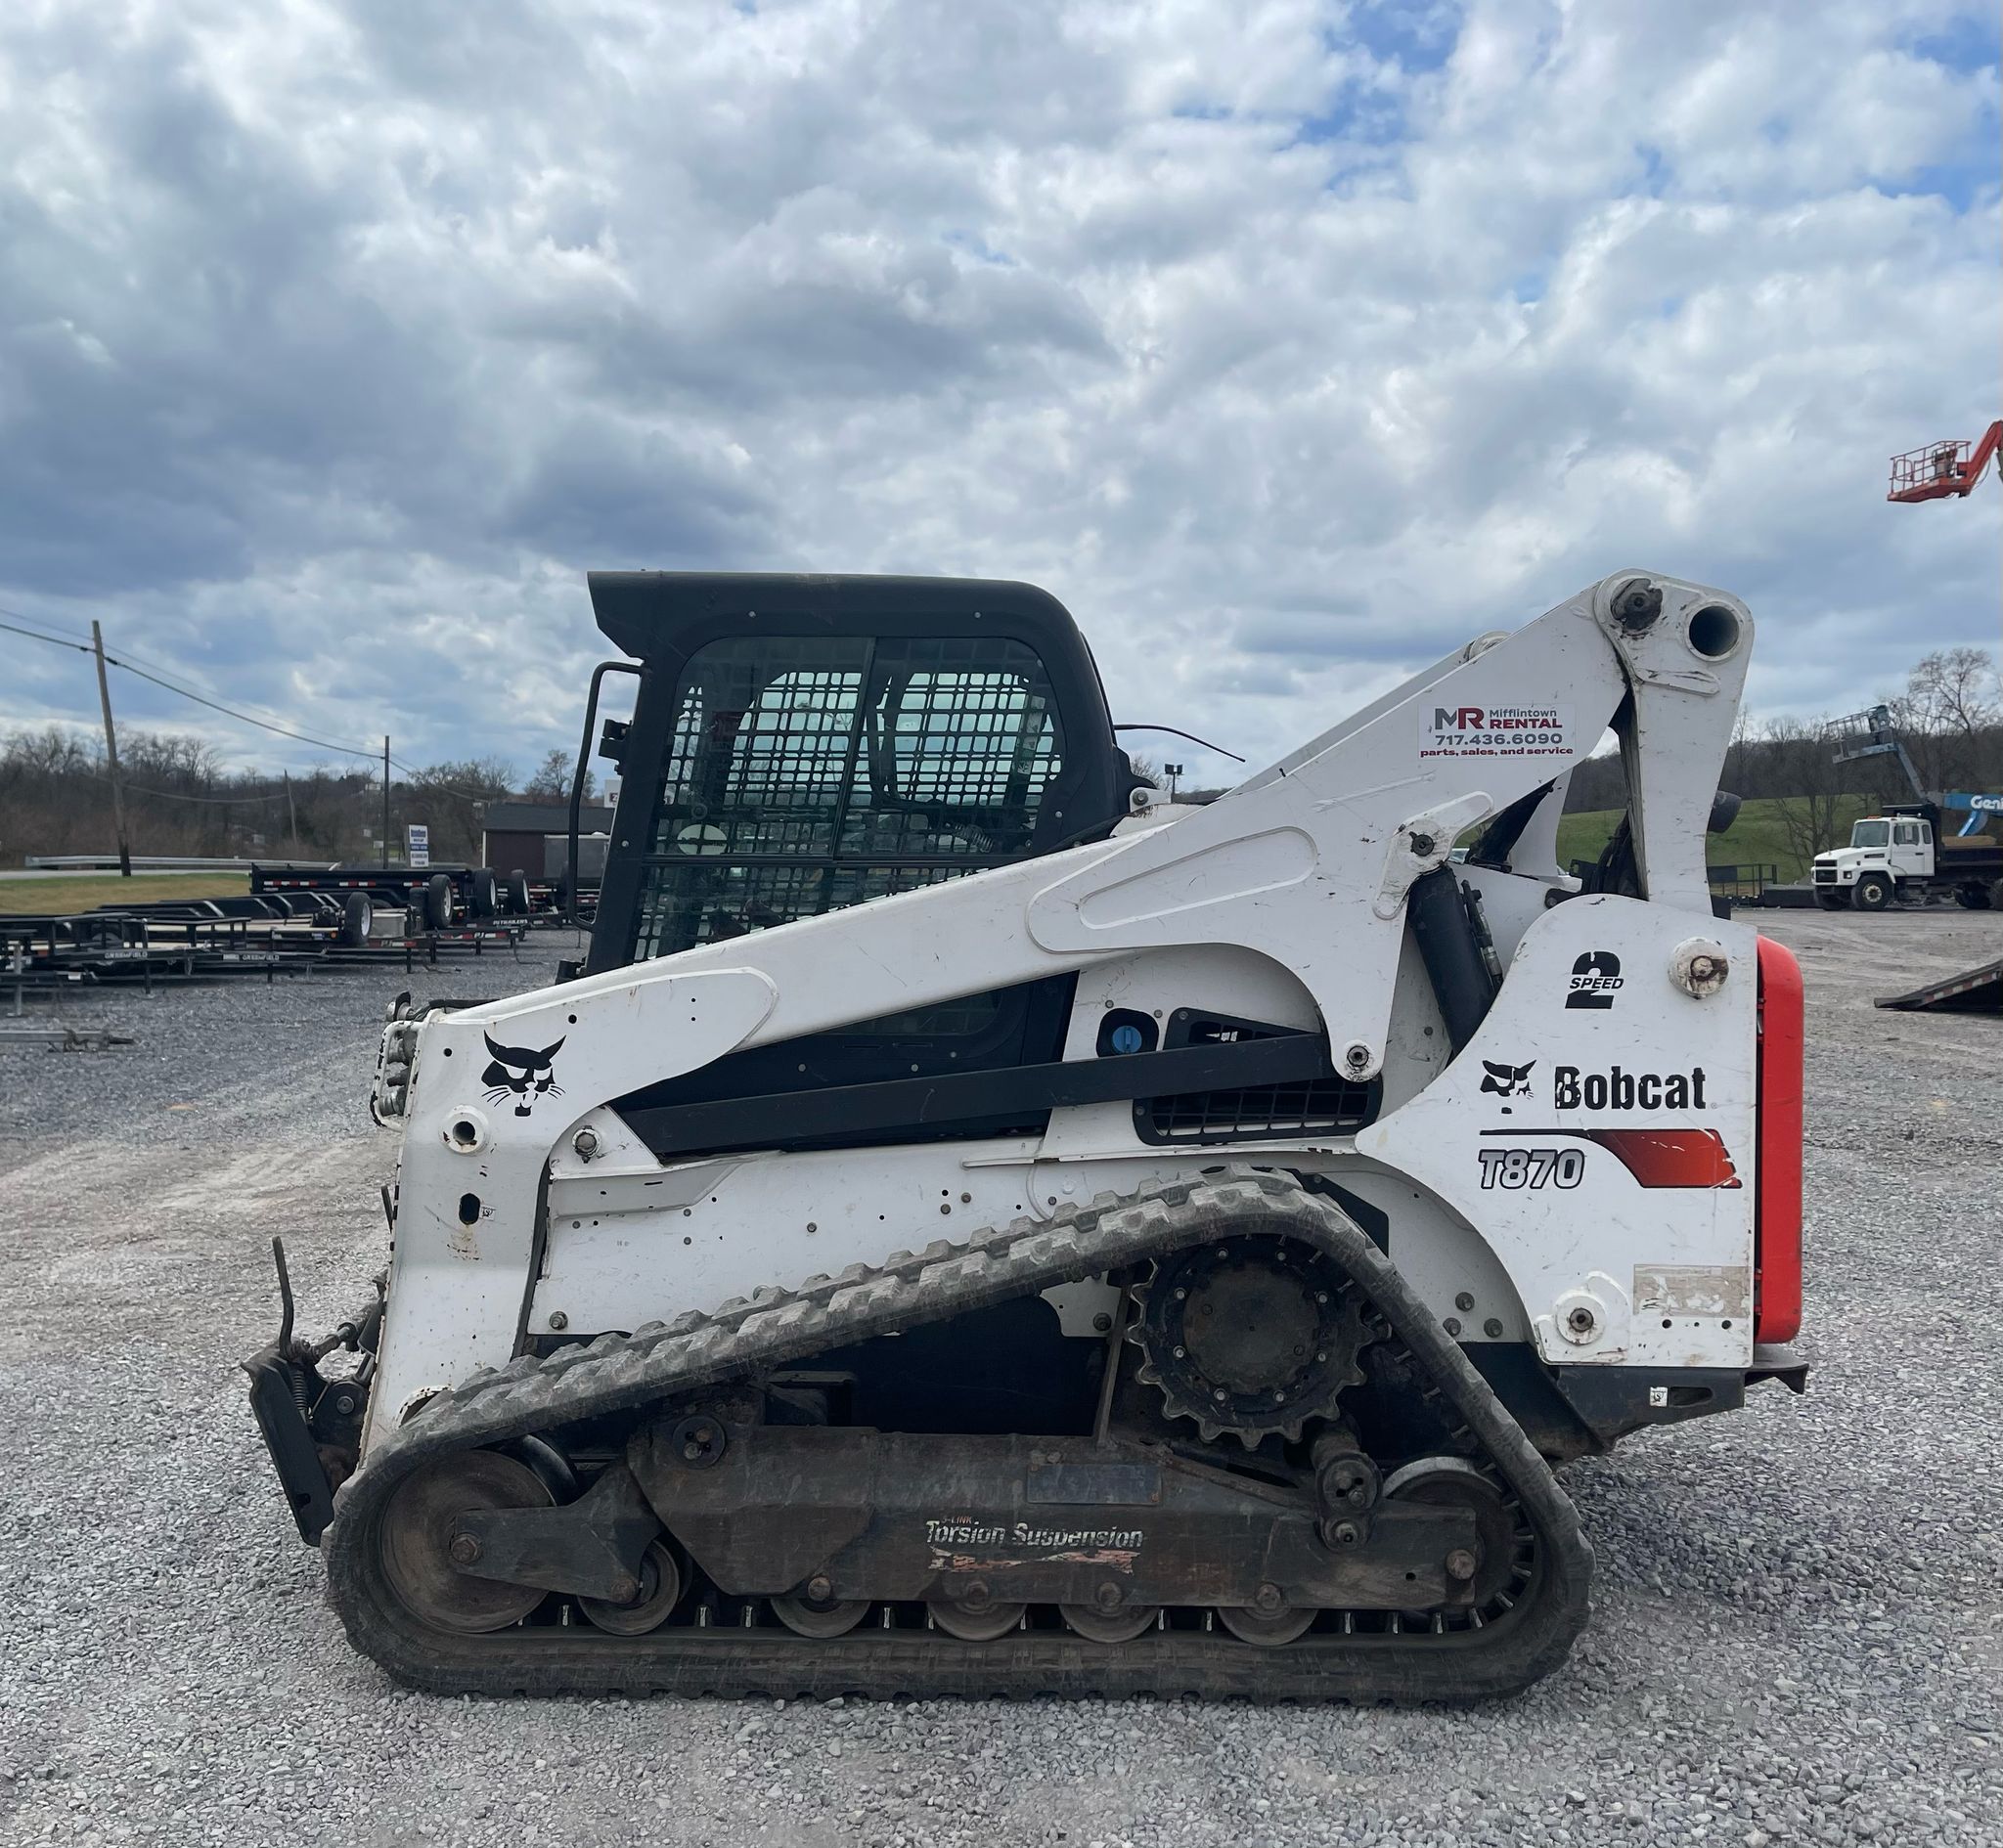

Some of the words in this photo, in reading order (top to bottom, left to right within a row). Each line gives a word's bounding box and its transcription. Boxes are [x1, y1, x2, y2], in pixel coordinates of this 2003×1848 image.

[1434, 707, 1485, 730] MR
[1489, 708, 1558, 719] Mifflintown
[1489, 718, 1563, 729] RENTAL
[1434, 732, 1564, 746] 717.436.6090
[1420, 747, 1459, 758] parts,
[1460, 747, 1498, 757] sales,
[1499, 746, 1525, 756] and
[1527, 746, 1574, 755] service
[1565, 950, 1621, 1009] 2
[1569, 977, 1625, 990] SPEED
[1554, 1065, 1707, 1111] Bobcat
[1478, 1148, 1585, 1190] T870
[925, 1519, 1006, 1545] Torsion
[1011, 1521, 1143, 1549] Suspension
